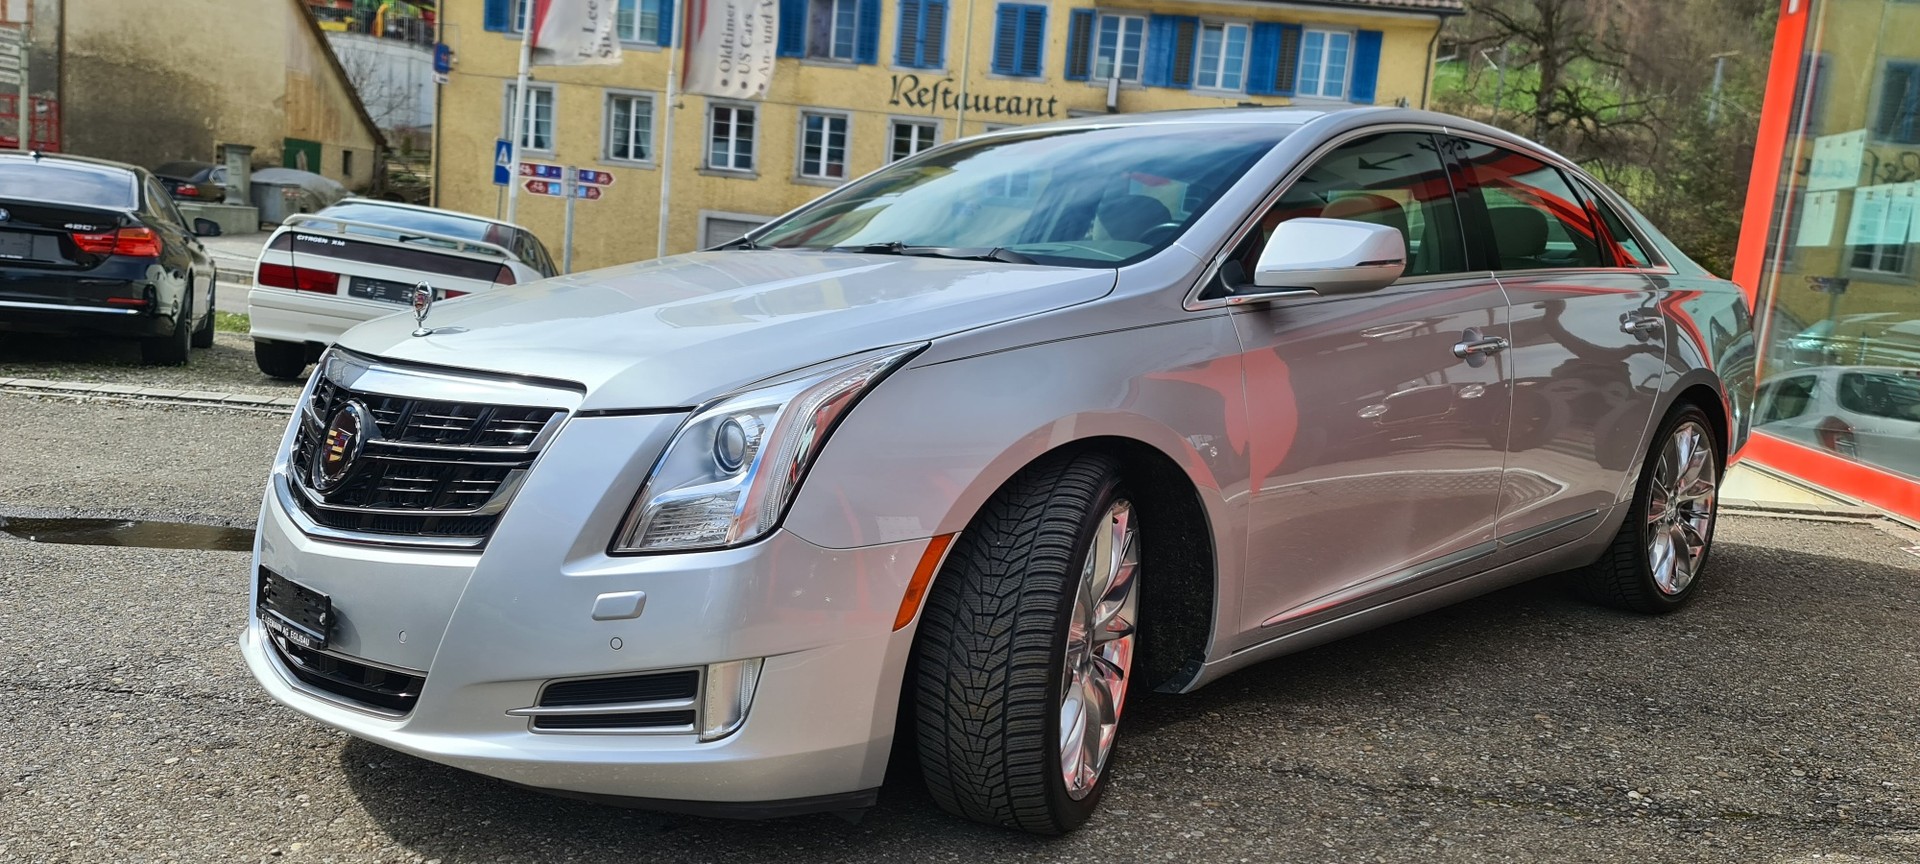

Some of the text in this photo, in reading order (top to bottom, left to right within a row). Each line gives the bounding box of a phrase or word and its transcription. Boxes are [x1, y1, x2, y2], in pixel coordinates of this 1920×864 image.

[718, 2, 735, 73] Oldtimer
[738, 13, 753, 74] US Cars
[760, 14, 774, 44] und
